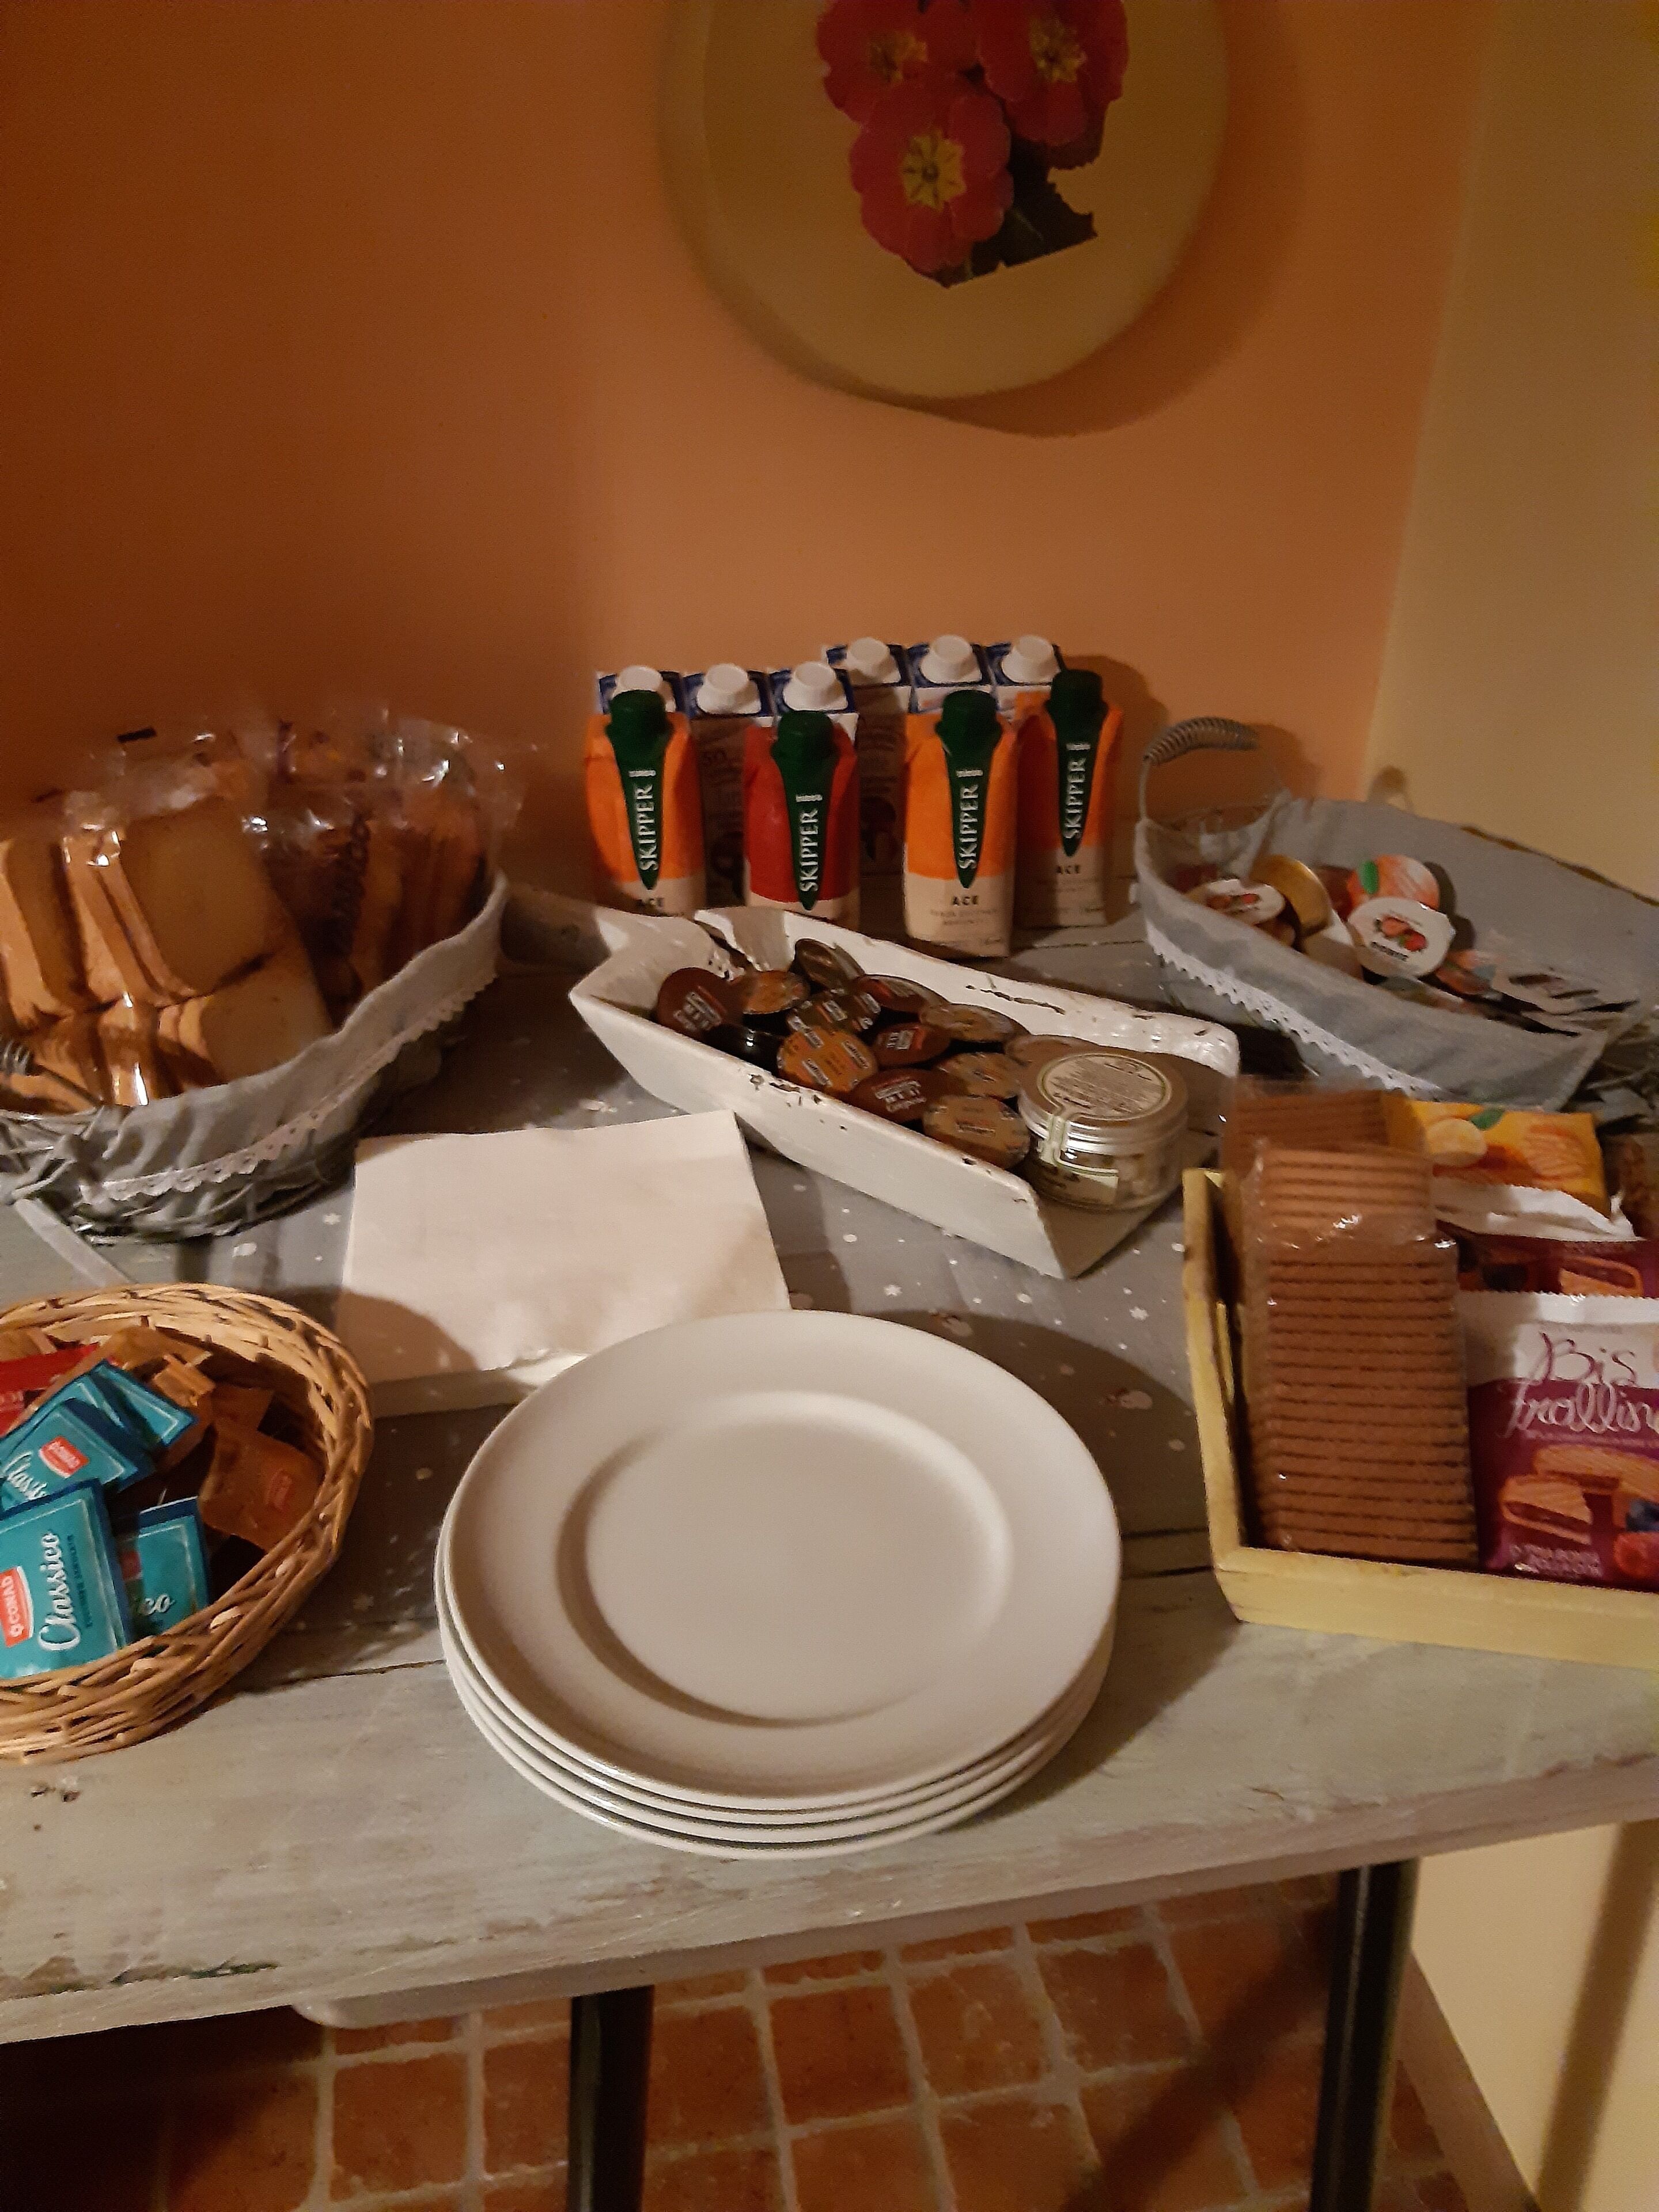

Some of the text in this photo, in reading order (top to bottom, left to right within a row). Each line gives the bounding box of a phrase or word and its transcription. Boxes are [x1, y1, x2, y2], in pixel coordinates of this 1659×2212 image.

[634, 784, 658, 871] SKIPPER
[959, 784, 979, 870] SKIPPER
[1064, 757, 1086, 840] SKIPPER
[800, 808, 819, 892] SKIPPER
[952, 895, 979, 906] ACE
[36, 1531, 81, 1652] Classico
